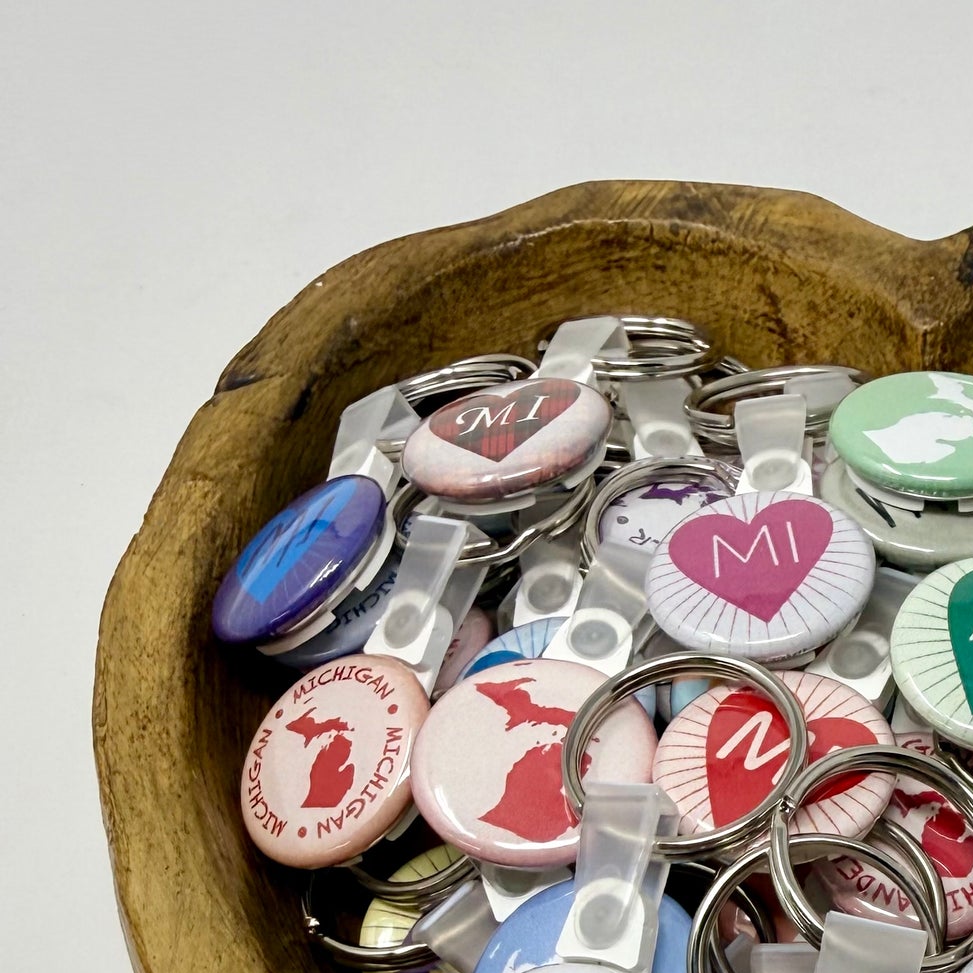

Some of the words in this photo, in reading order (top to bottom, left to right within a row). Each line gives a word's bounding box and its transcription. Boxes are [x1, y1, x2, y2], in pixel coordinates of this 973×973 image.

[455, 395, 550, 435] MI
[712, 521, 800, 578] MI
[293, 665, 395, 704] MICHIGAN
[716, 711, 844, 785] M
[248, 728, 288, 838] MICHIGAN
[317, 727, 403, 838] MICHIGAN
